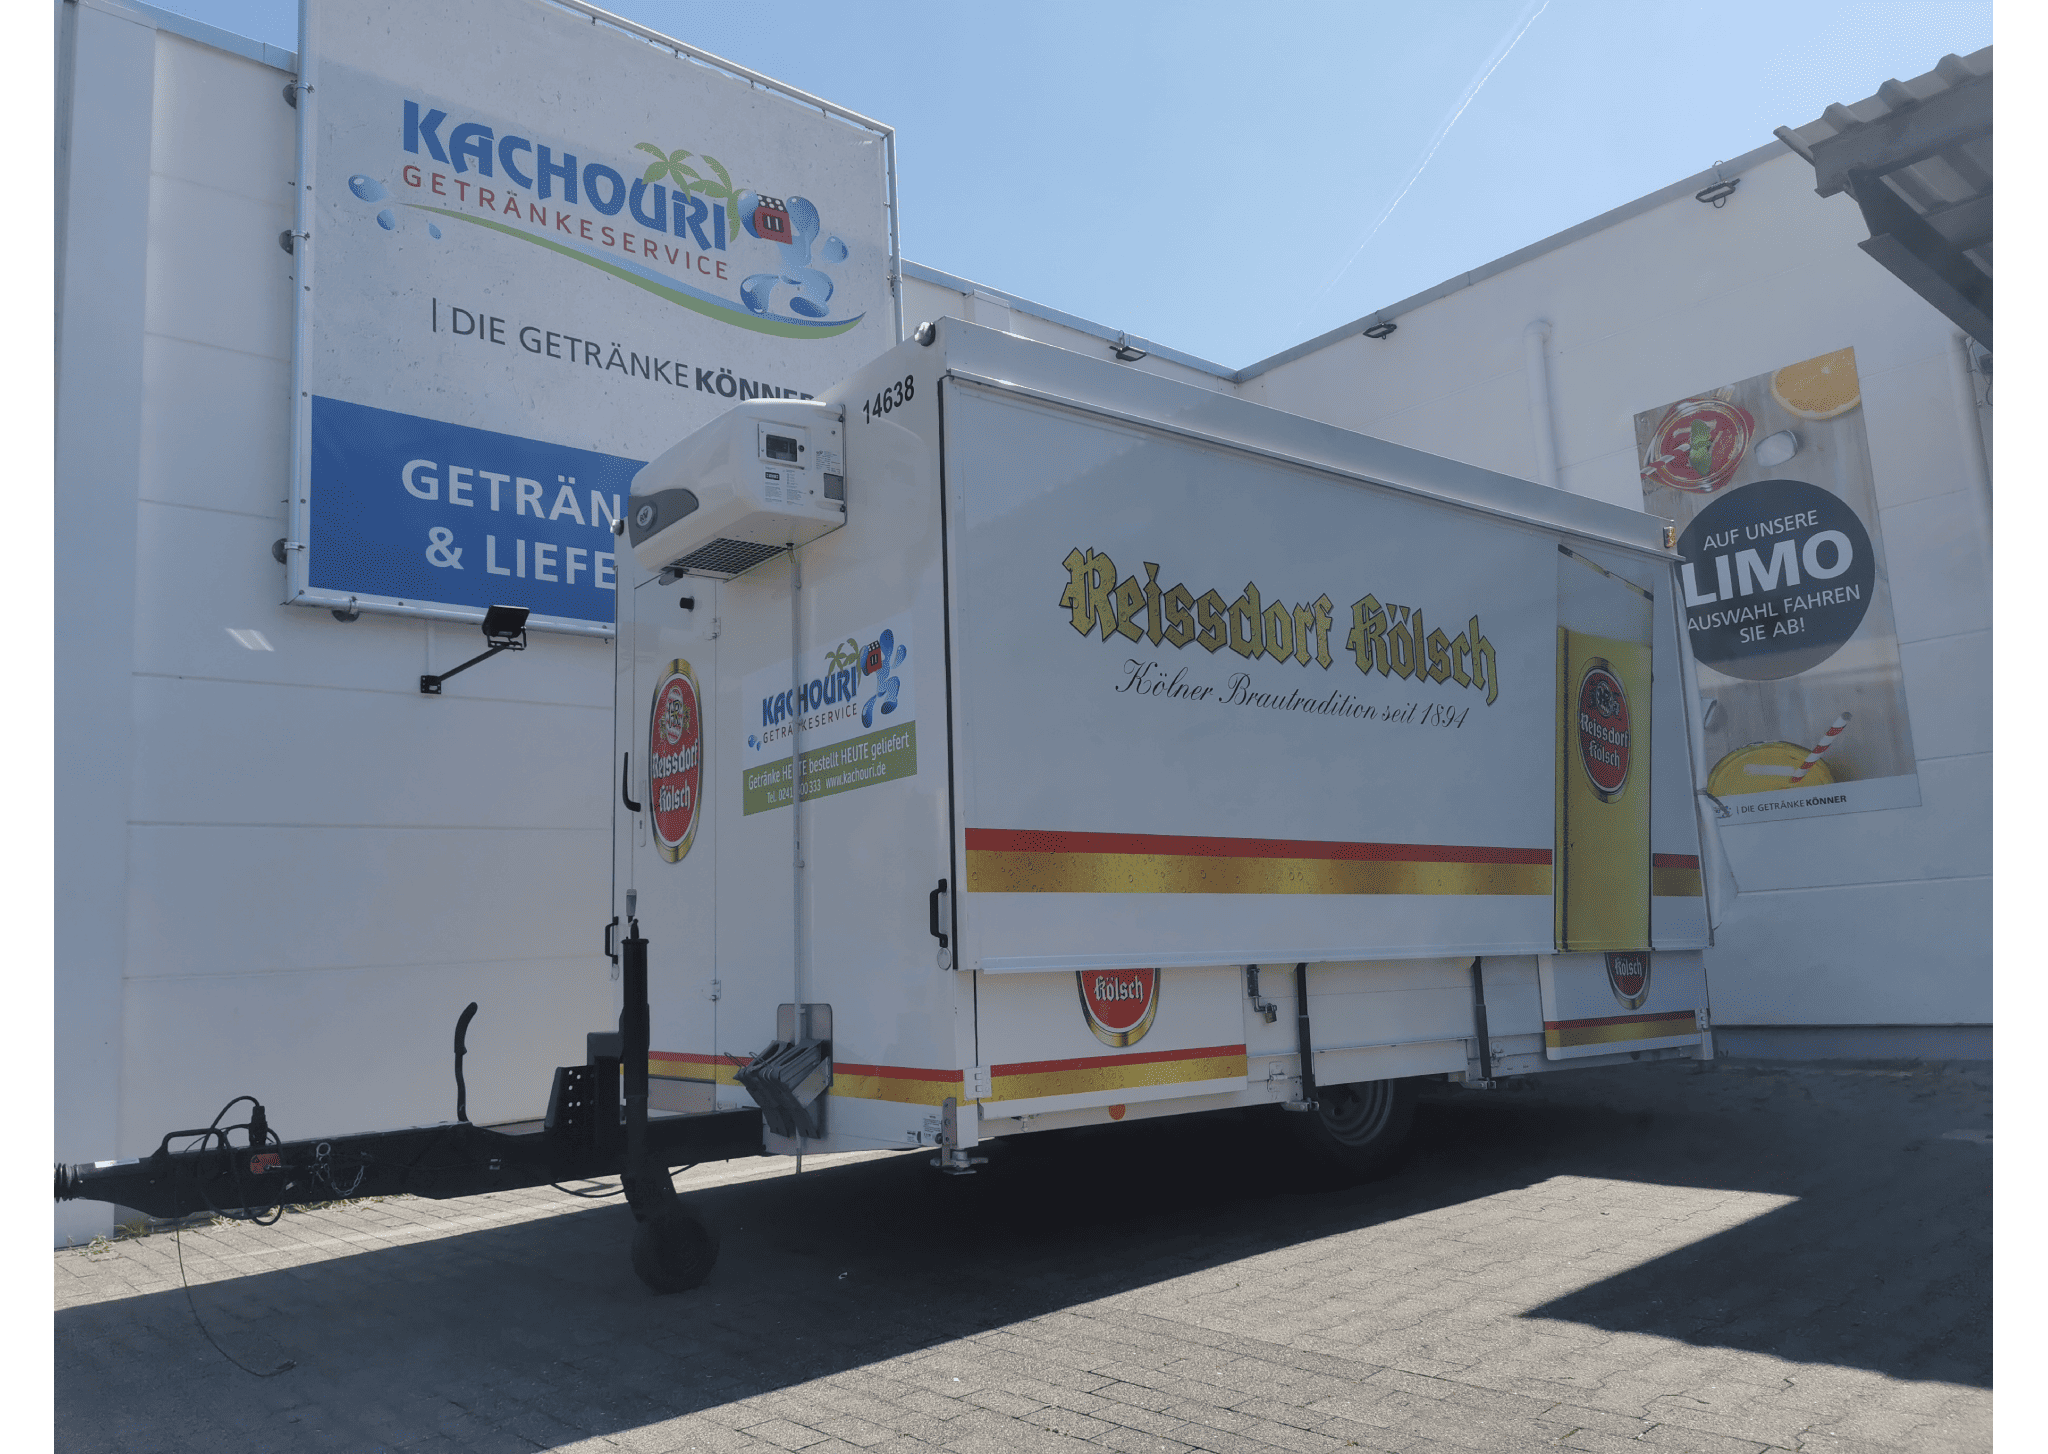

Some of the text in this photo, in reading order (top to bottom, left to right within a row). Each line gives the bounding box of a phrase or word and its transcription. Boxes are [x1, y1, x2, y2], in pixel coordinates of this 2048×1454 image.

[403, 99, 726, 251] KACHOURI
[402, 165, 729, 281] GETRÄNKESERVICE
[452, 306, 506, 345] DIE
[862, 374, 915, 424] 14638
[425, 526, 464, 570] &
[1703, 510, 1819, 551] AUF UNSERE
[1681, 529, 1854, 608] LIMO
[1059, 546, 1499, 706] Reissdorf Kölsch
[1688, 584, 1861, 631] AUSWAHL FAHREN
[1739, 617, 1806, 644] SIE AB!
[1114, 659, 1470, 729] Kölner Brautradition seit 1894
[1580, 711, 1629, 748] Reissdorf
[653, 738, 698, 779] Reissdorf
[748, 769, 780, 791] Getränke
[808, 751, 839, 774] bestellt
[841, 742, 868, 764] HEUTE
[871, 731, 909, 761] geliefert
[825, 762, 886, 789] www.kachouri.de
[1589, 740, 1620, 770] Kölsch
[659, 778, 690, 812] Kölsch
[1741, 804, 1755, 814] DIE
[1614, 956, 1642, 977] Kölsch
[1094, 975, 1144, 1004] Kölsch
